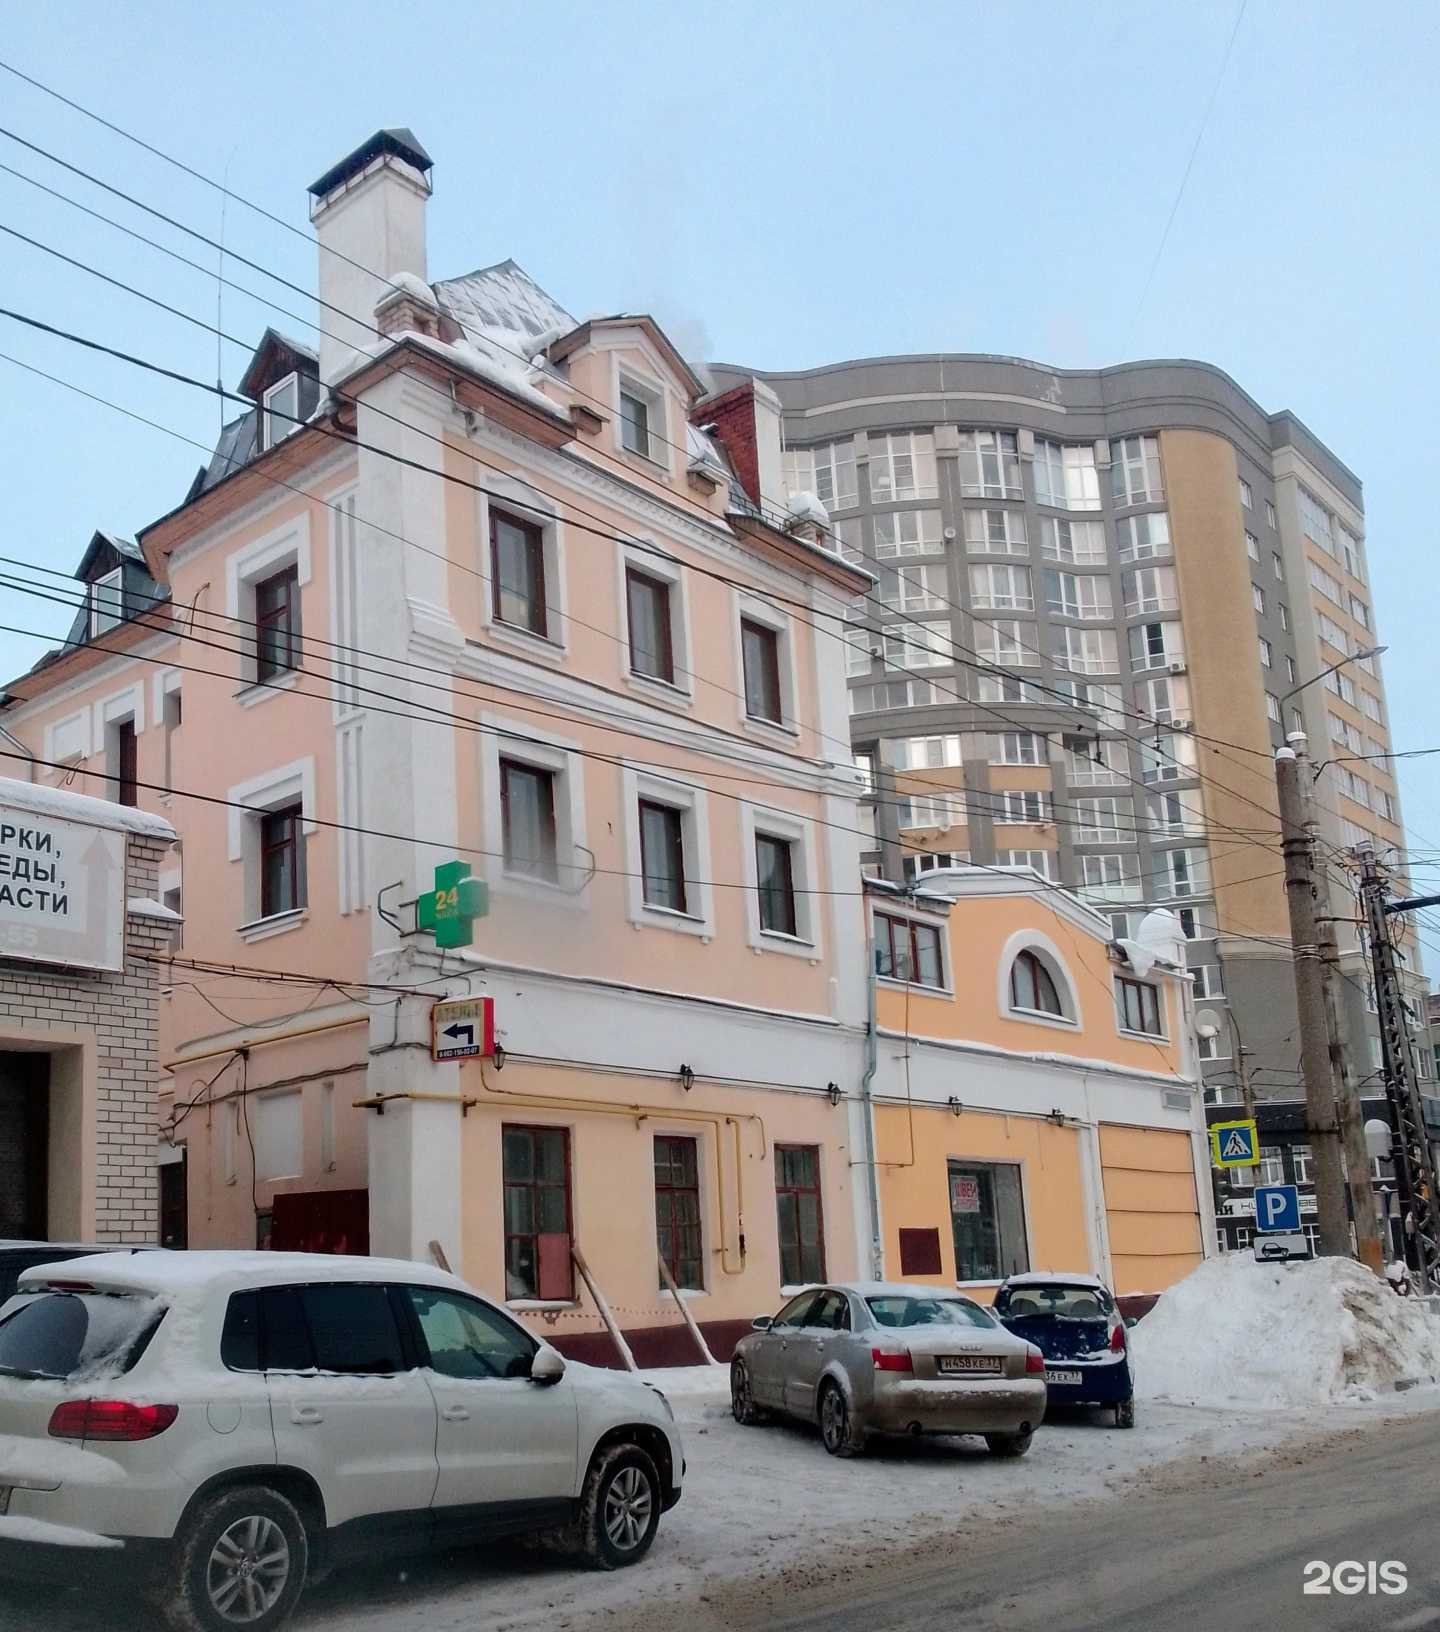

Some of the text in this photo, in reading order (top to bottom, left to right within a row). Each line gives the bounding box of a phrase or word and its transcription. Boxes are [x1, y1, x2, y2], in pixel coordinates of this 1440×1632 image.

[1, 824, 60, 858] РКИ,
[0, 884, 68, 915] АСТИ
[435, 886, 458, 911] 24
[1265, 1193, 1287, 1226] P
